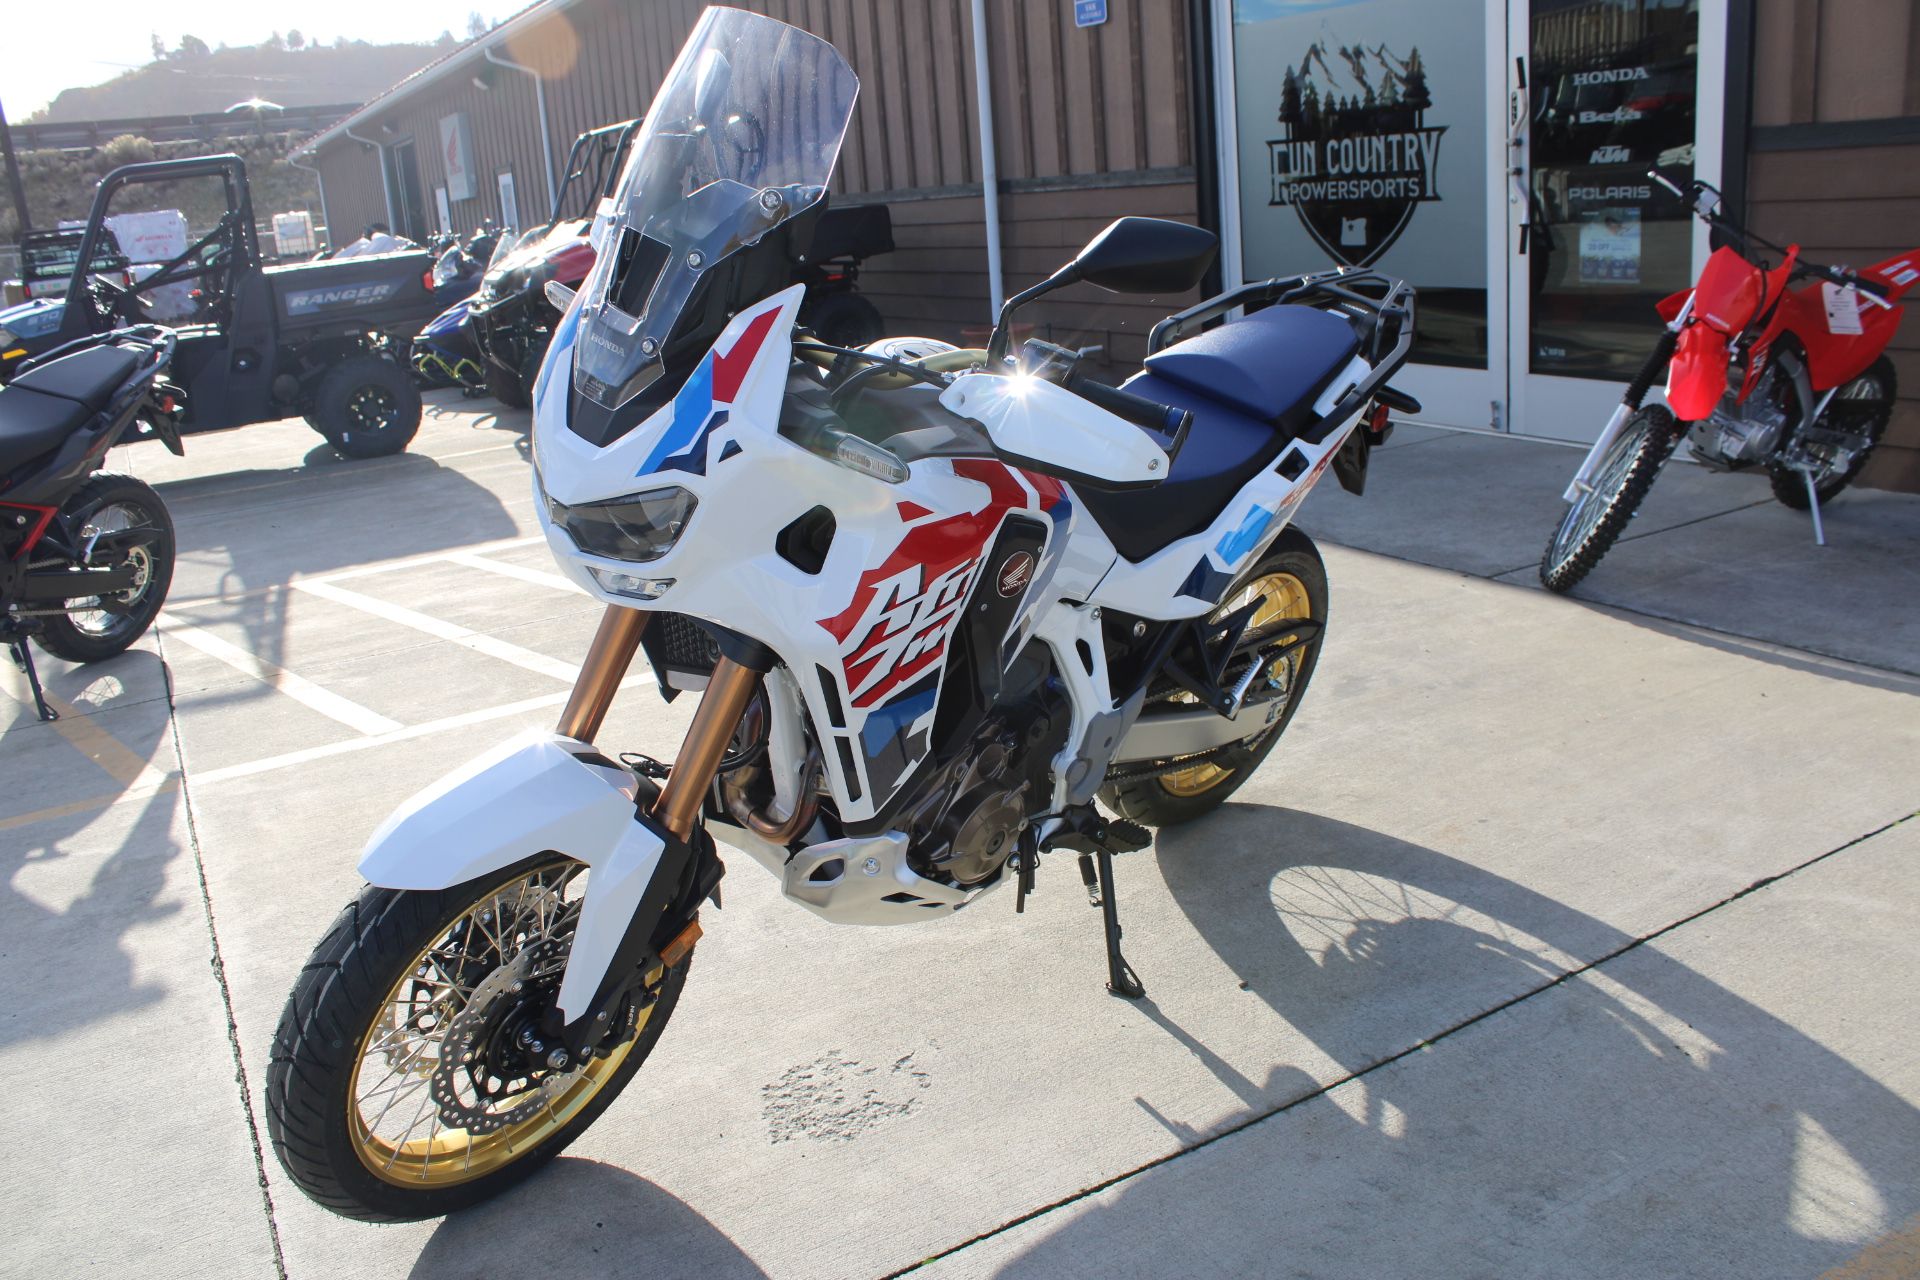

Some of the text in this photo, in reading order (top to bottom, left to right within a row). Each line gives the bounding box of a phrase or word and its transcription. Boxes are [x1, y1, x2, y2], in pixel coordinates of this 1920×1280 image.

[1573, 66, 1650, 86] HONDA
[1579, 106, 1642, 124] Beta
[1589, 145, 1630, 164] KTM
[1271, 131, 1440, 202] FUN COUNTRY
[1290, 177, 1420, 200] POWERSPORTS
[1568, 185, 1651, 200] POLARIS
[290, 284, 390, 307] RANGER
[591, 333, 625, 357] HONDA
[1002, 578, 1027, 592] HONDA
